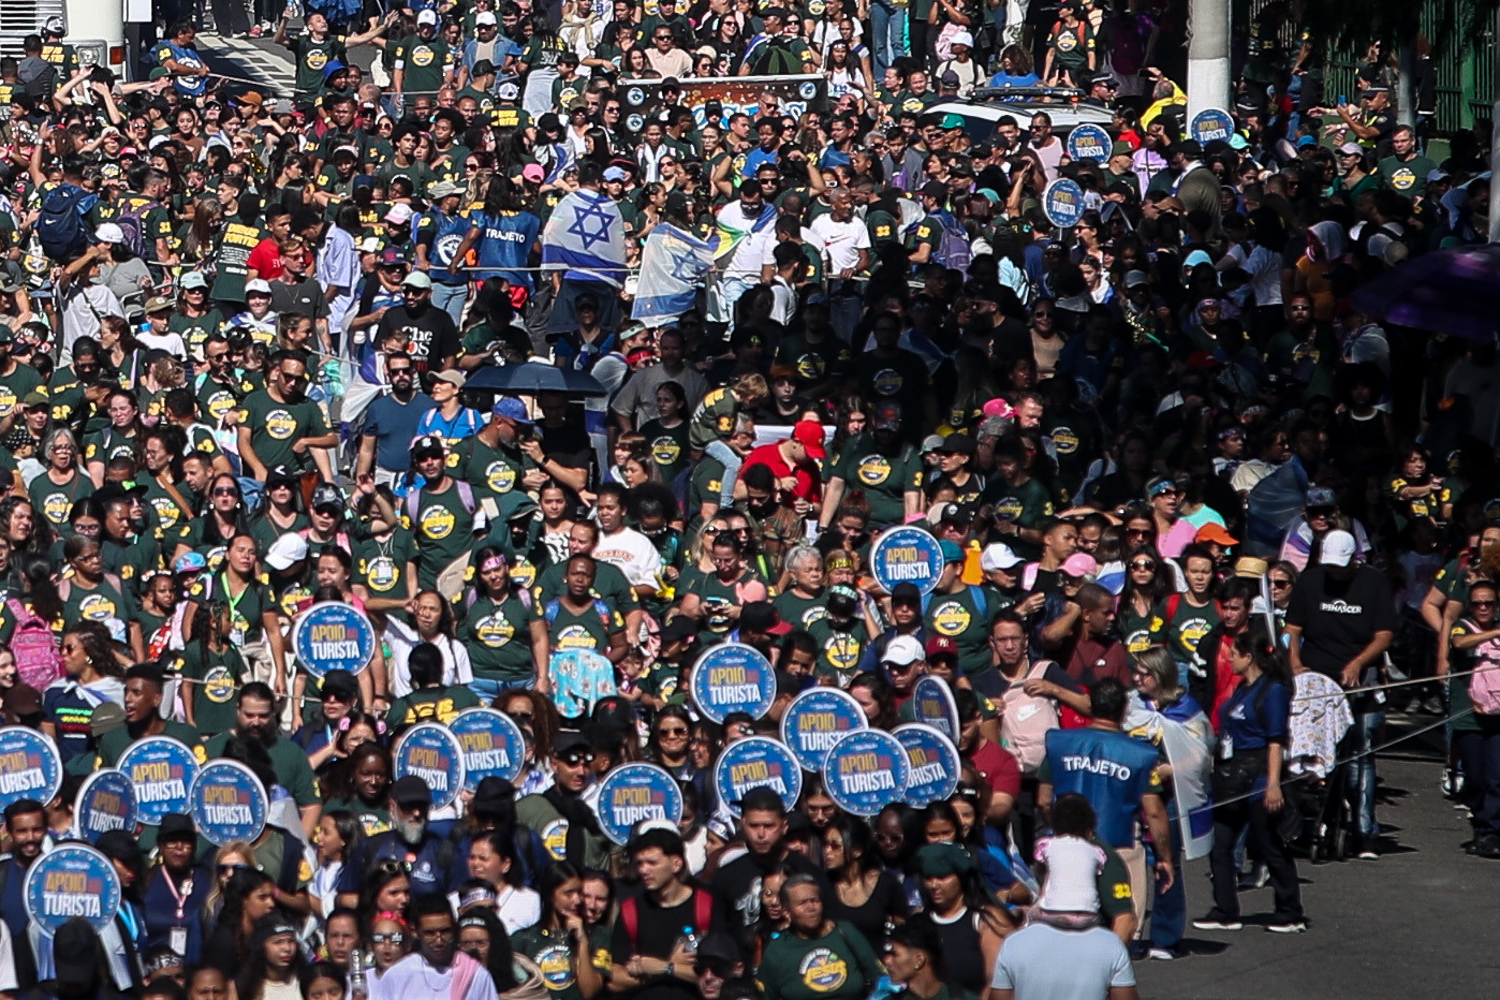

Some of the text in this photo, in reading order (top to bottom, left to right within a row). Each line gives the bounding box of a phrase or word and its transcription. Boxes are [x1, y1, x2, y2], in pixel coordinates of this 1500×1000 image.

[1199, 127, 1227, 142] TURISTA
[1076, 145, 1104, 158] TURISTA
[1052, 201, 1076, 217] TURISTA
[485, 228, 526, 244] TRAJETO
[886, 547, 918, 562] APOIO
[885, 561, 931, 580] TURISTA
[312, 624, 346, 642] APOIO
[311, 642, 360, 661] TURISTA
[710, 667, 746, 685] APOIO
[710, 684, 762, 705] TURISTA
[799, 712, 836, 730] APOIO
[408, 747, 439, 767] APOIO
[840, 752, 878, 773] APOIO
[133, 761, 170, 783] APOIO
[731, 761, 768, 783] APOIO
[1062, 756, 1131, 781] TRAJETO
[134, 779, 186, 803] TURISTA
[840, 770, 896, 795] TURISTA
[204, 785, 238, 805] APOIO
[614, 787, 651, 806] APOIO
[204, 804, 253, 825] TURISTA
[45, 872, 87, 893] APOIO
[43, 893, 101, 917] TURISTA
